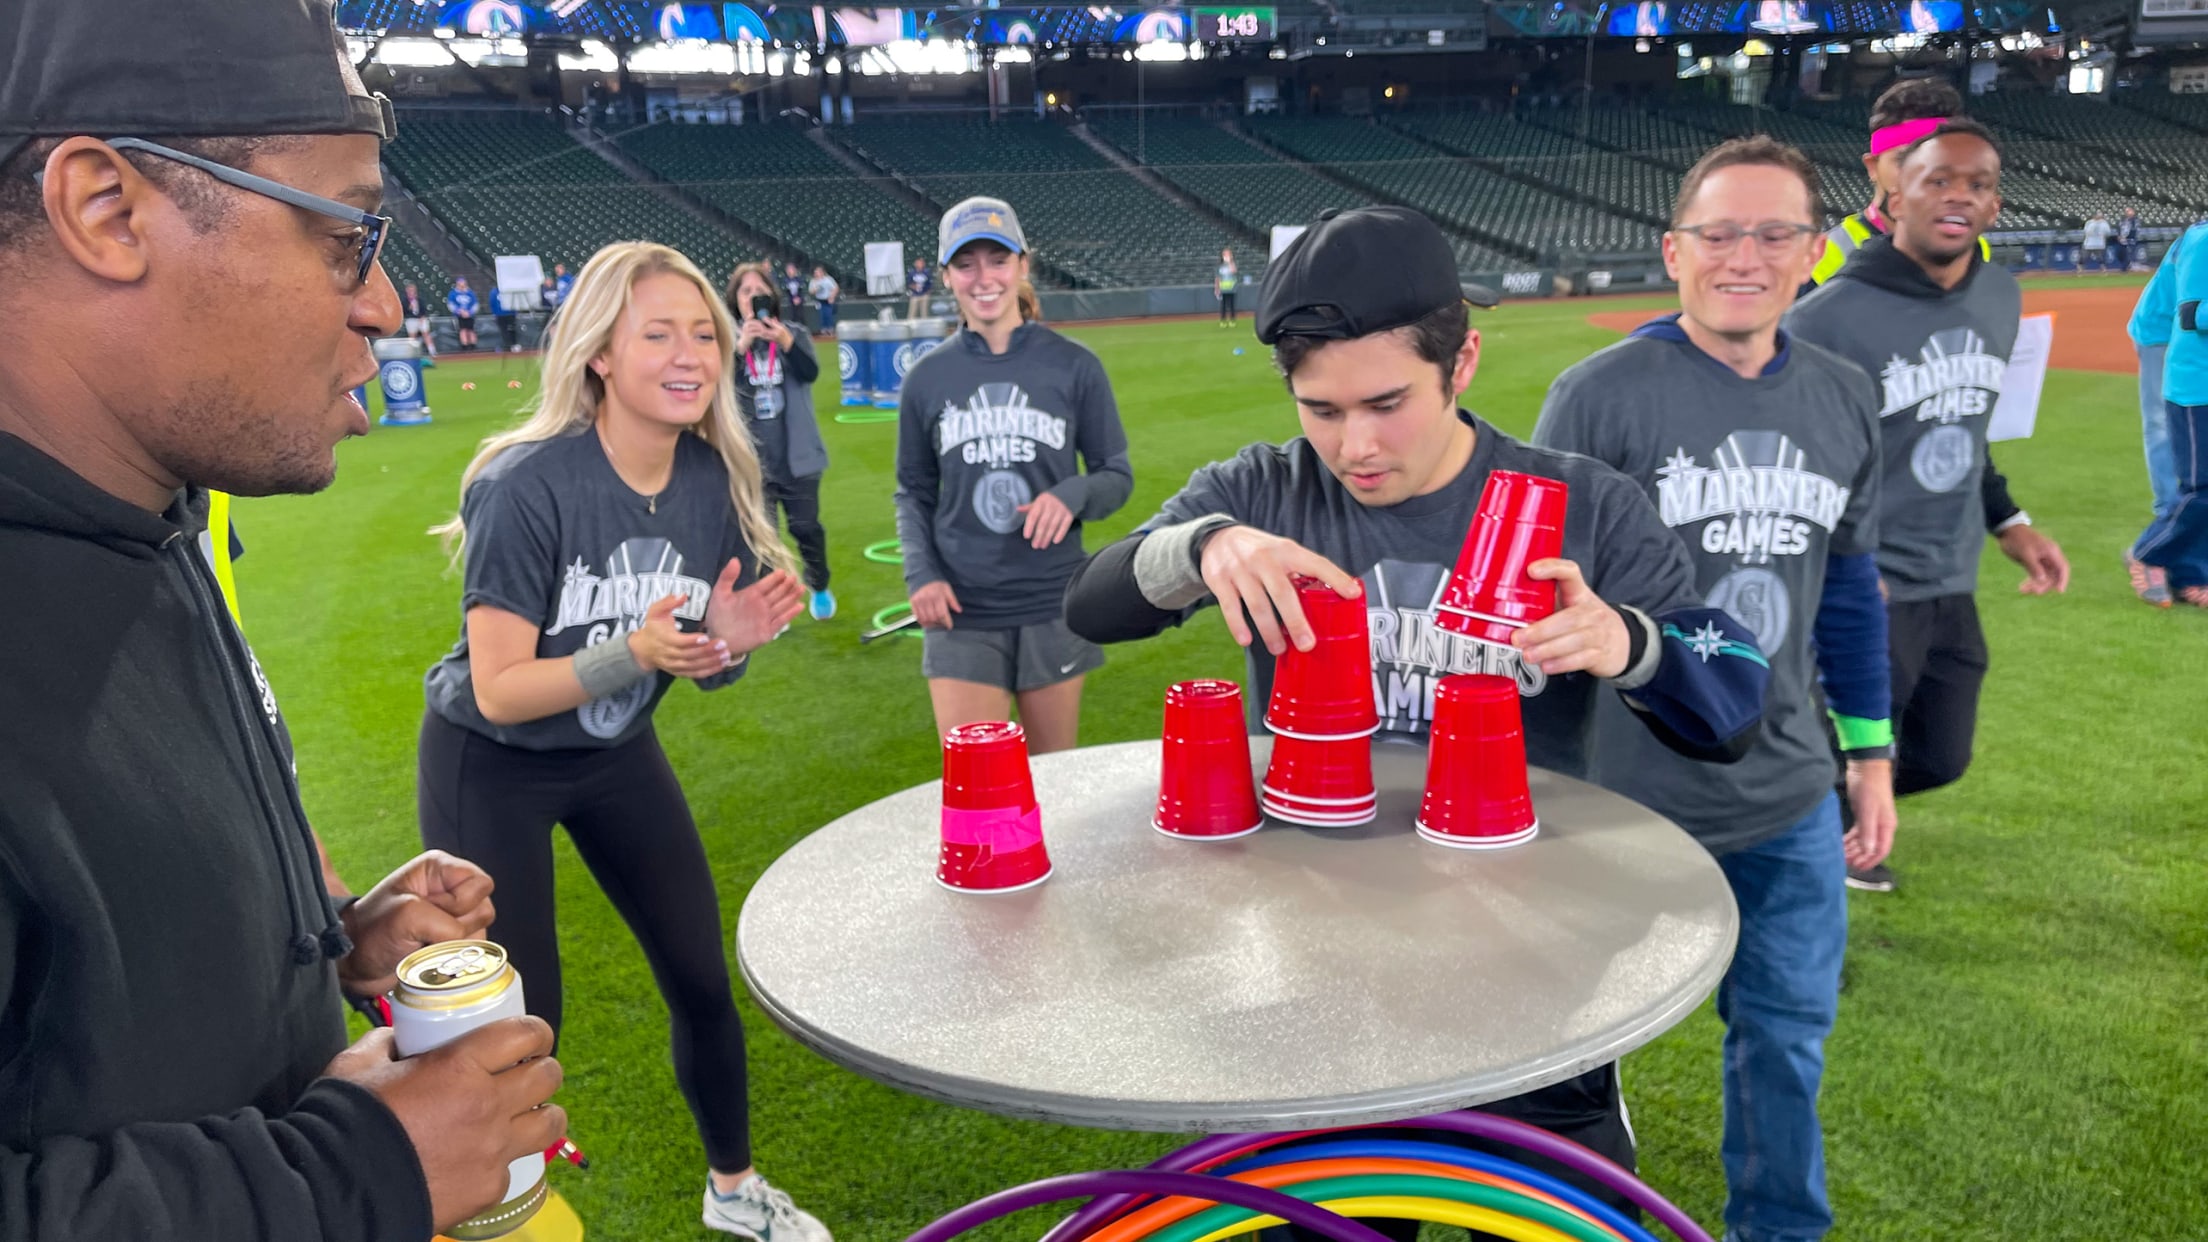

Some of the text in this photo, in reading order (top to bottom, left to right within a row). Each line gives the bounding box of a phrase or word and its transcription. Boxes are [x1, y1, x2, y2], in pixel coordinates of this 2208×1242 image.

[1217, 13, 1258, 36] 1:43
[939, 405, 1066, 456] MARINERS
[962, 438, 1036, 465] GAMES
[1702, 516, 1811, 555] GAMES
